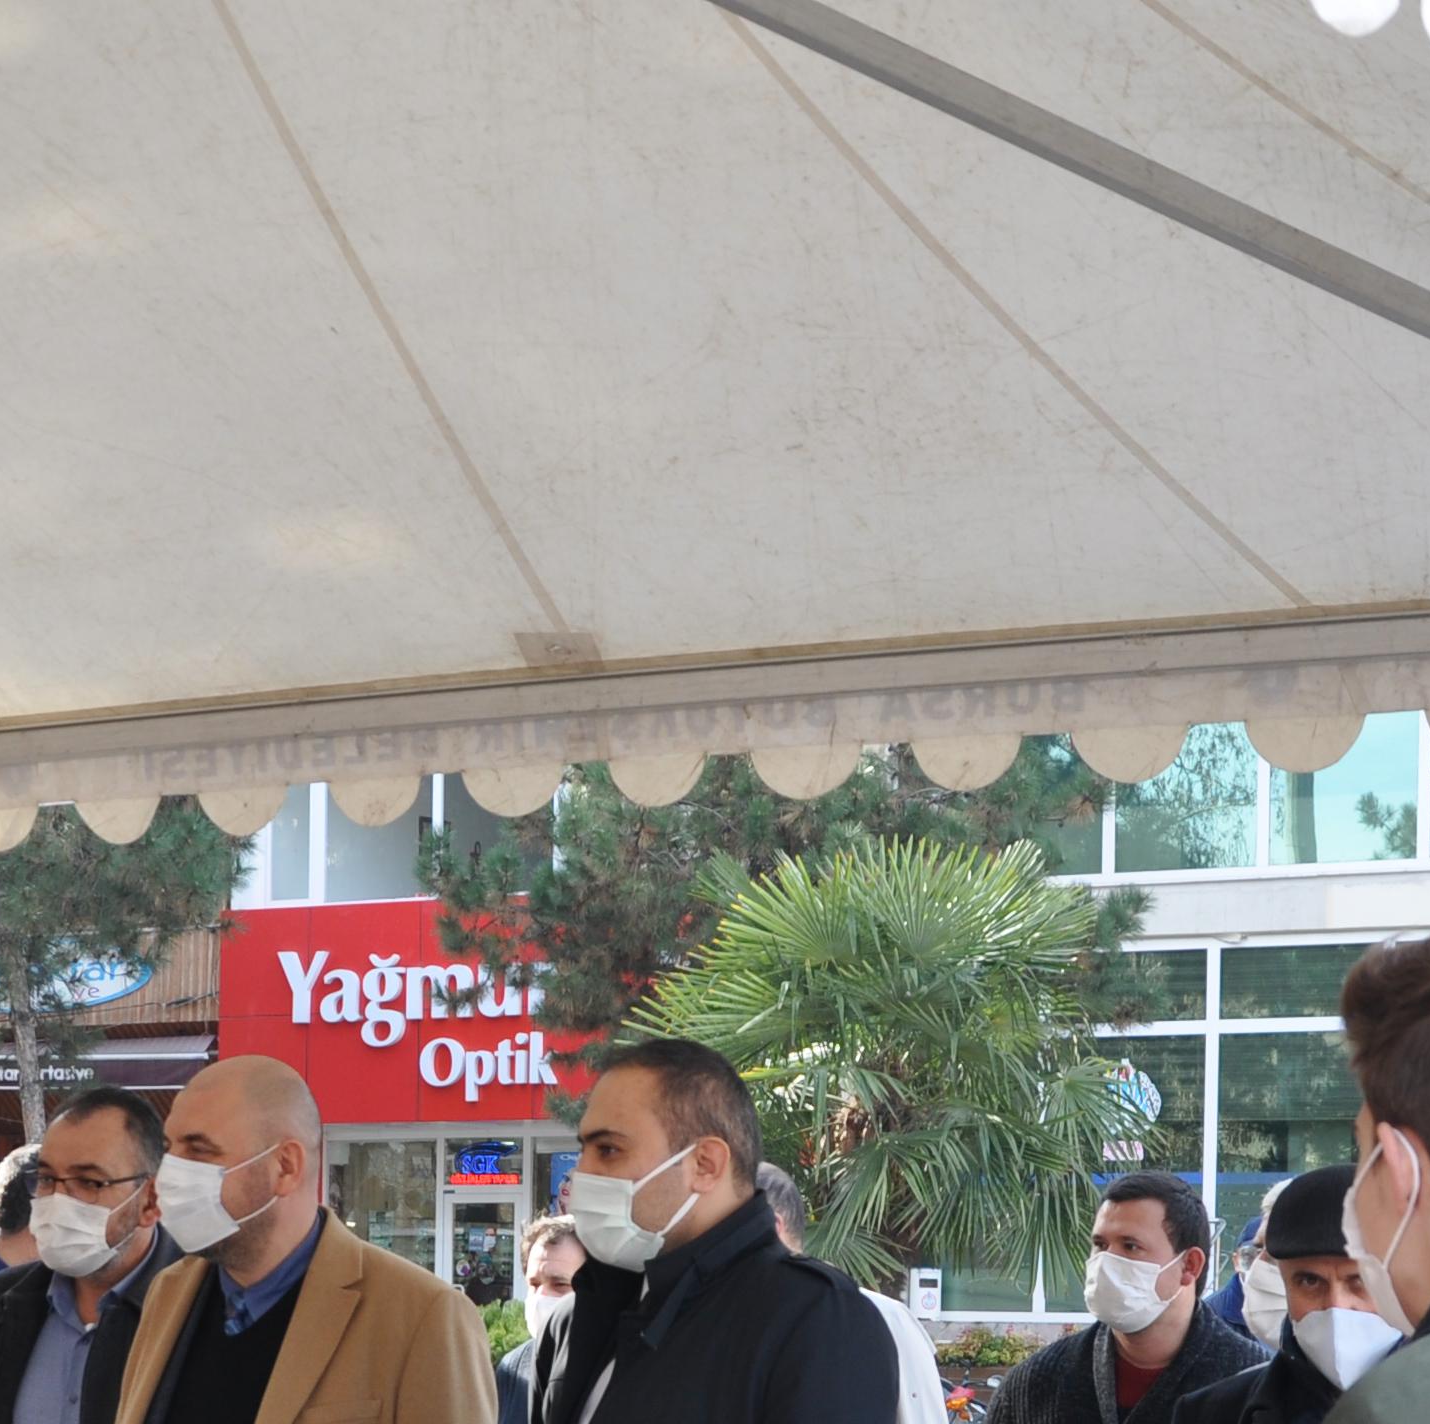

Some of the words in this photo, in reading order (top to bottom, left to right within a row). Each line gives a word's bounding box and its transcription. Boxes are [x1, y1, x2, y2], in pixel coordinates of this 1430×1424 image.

[276, 949, 547, 1048] Yağmur
[39, 1065, 94, 1081] rtasiye
[419, 1030, 558, 1102] Optik
[461, 1154, 500, 1175] SGK
